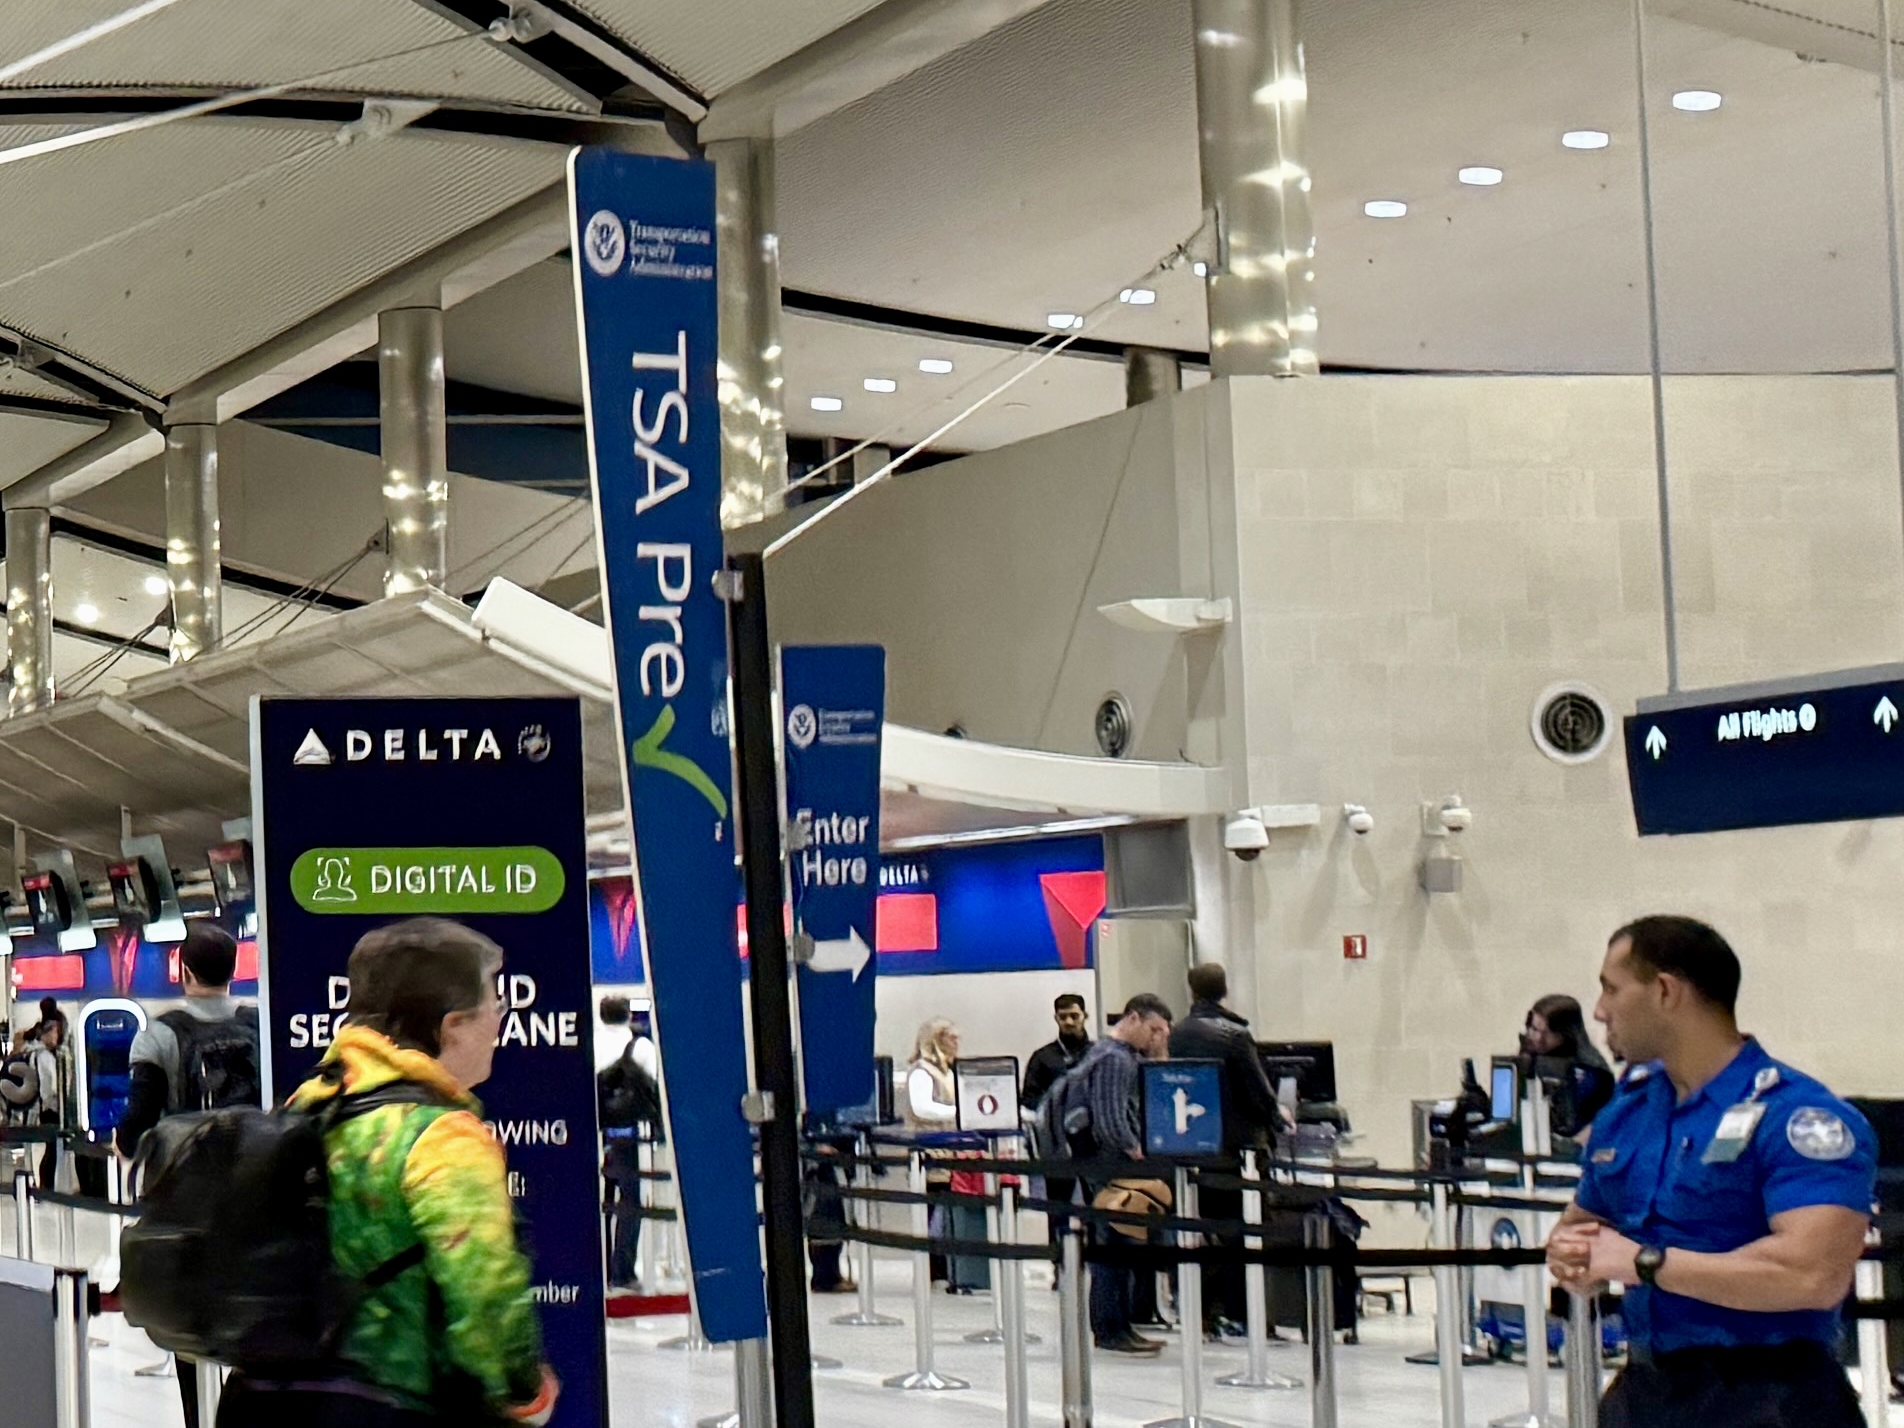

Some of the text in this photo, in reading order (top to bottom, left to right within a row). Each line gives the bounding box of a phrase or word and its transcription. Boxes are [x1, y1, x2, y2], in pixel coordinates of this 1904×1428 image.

[631, 329, 693, 699] TSA Pre
[1717, 707, 1798, 742] All Flights
[345, 727, 502, 762] DELTA
[794, 807, 870, 846] Enter
[371, 864, 537, 895] DIGITAL ID
[802, 849, 868, 887] Here
[878, 864, 920, 887] DELTA
[493, 1011, 579, 1048] ANE
